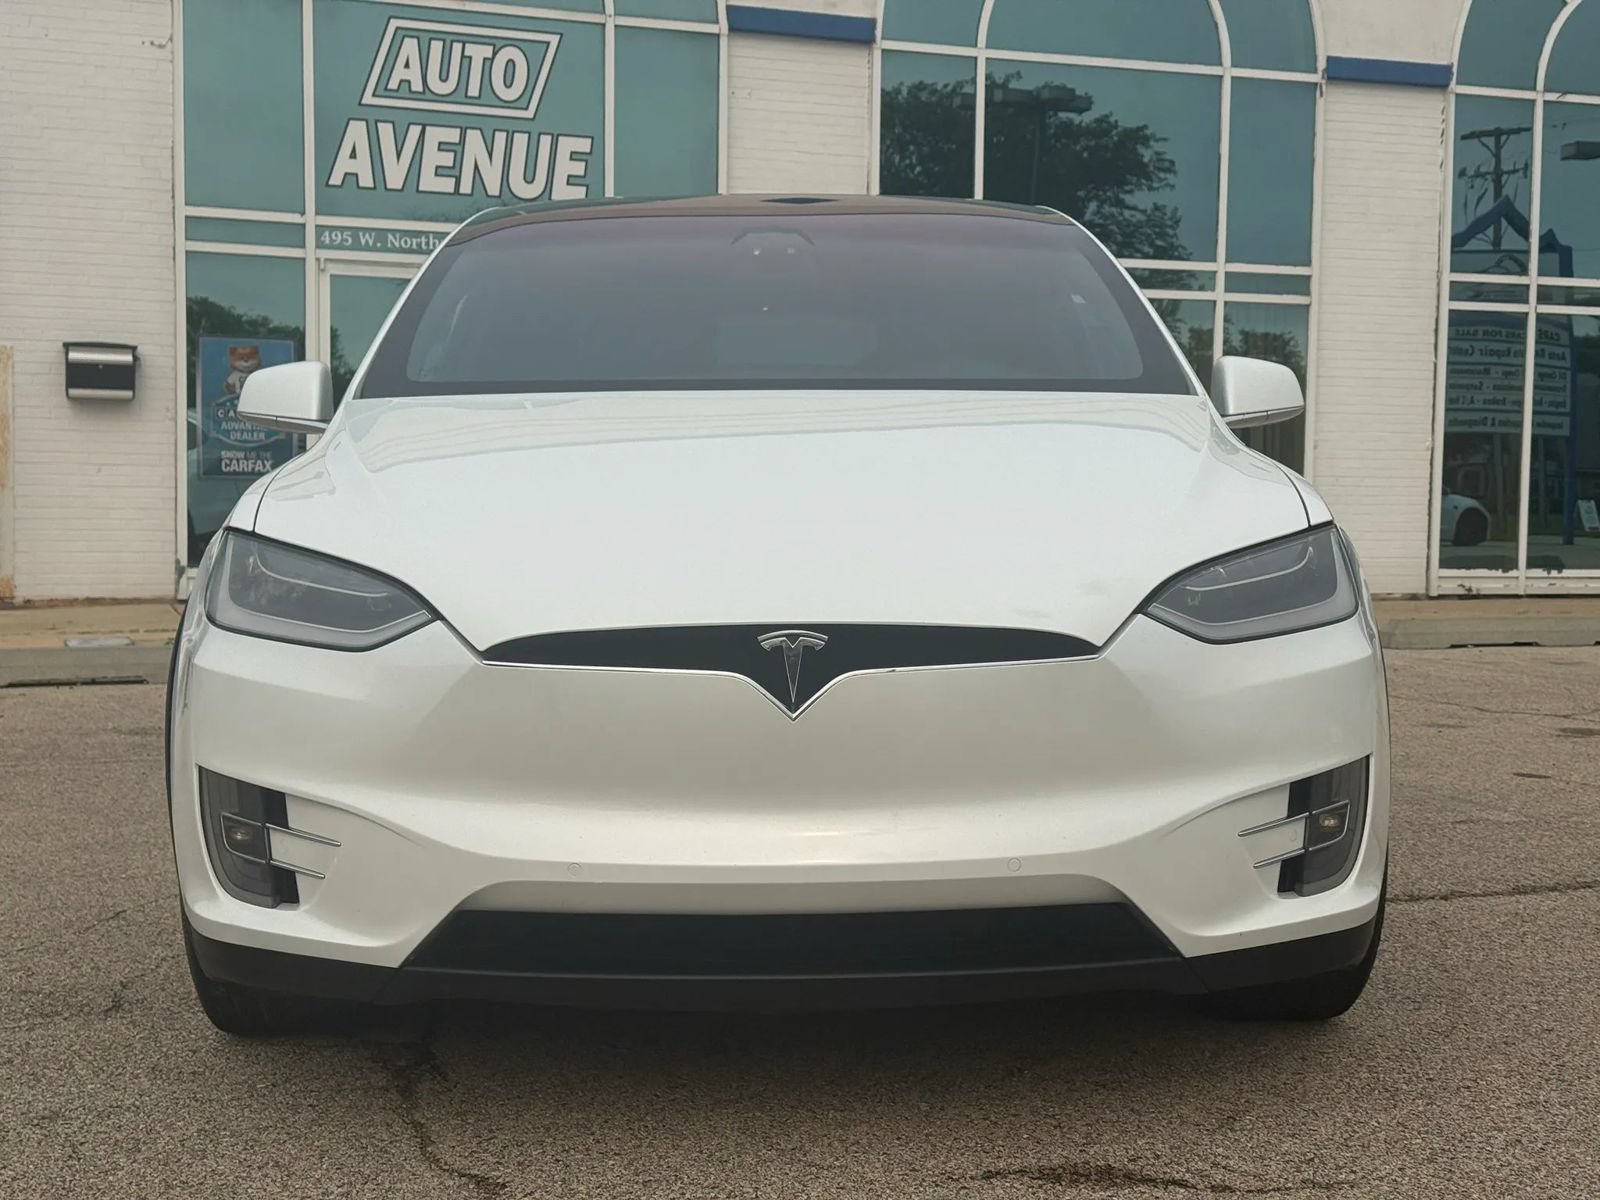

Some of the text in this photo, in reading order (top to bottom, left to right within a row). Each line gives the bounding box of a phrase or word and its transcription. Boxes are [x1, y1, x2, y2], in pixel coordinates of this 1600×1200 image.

[385, 35, 529, 102] AUTO
[325, 117, 594, 201] AVENUE
[320, 230, 444, 250] 495 W. North
[230, 431, 265, 441] DEALER
[221, 459, 273, 473] CARFAX
